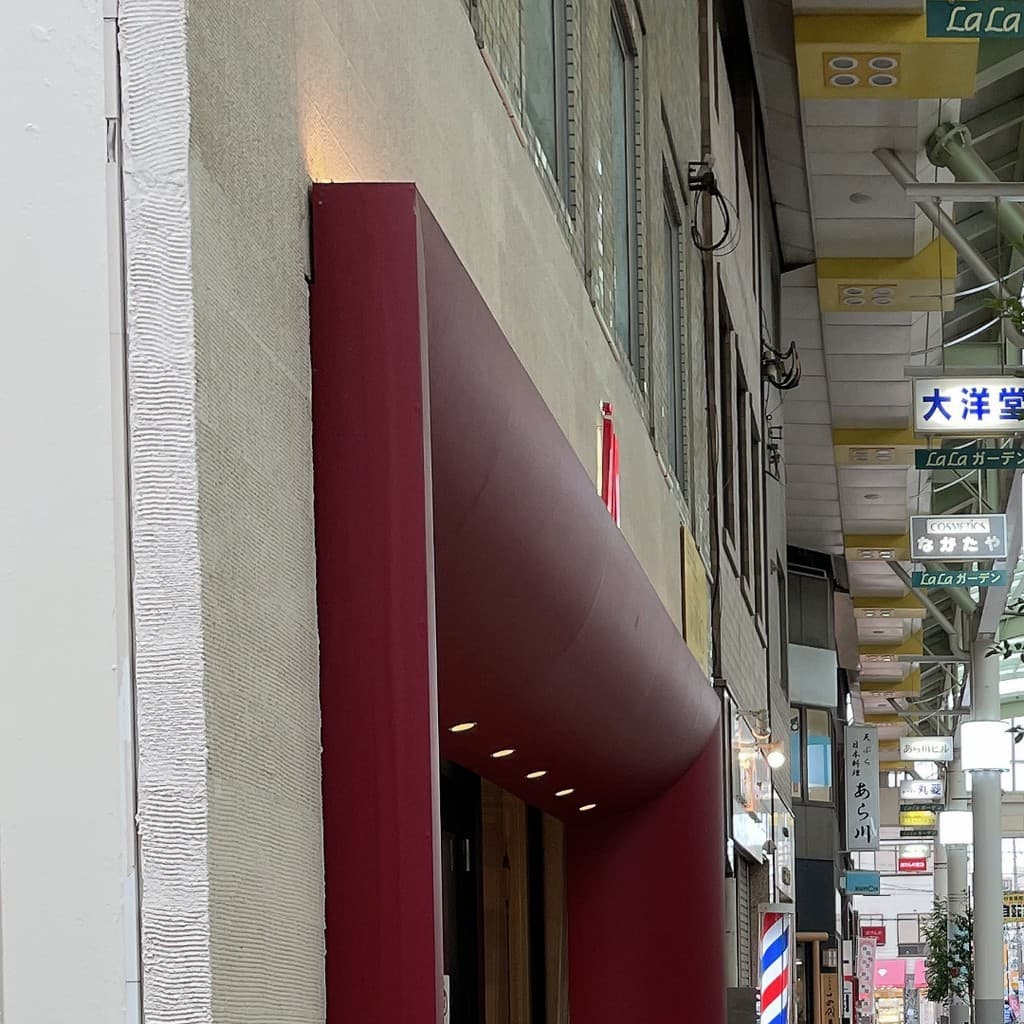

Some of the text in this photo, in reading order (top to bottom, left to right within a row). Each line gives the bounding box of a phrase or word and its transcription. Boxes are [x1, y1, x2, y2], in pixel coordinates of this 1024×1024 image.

[946, 6, 1021, 33] LaLa
[926, 451, 968, 467] LaLa
[920, 572, 1001, 586] LaLa ガーデン
[854, 782, 871, 844] あら川
